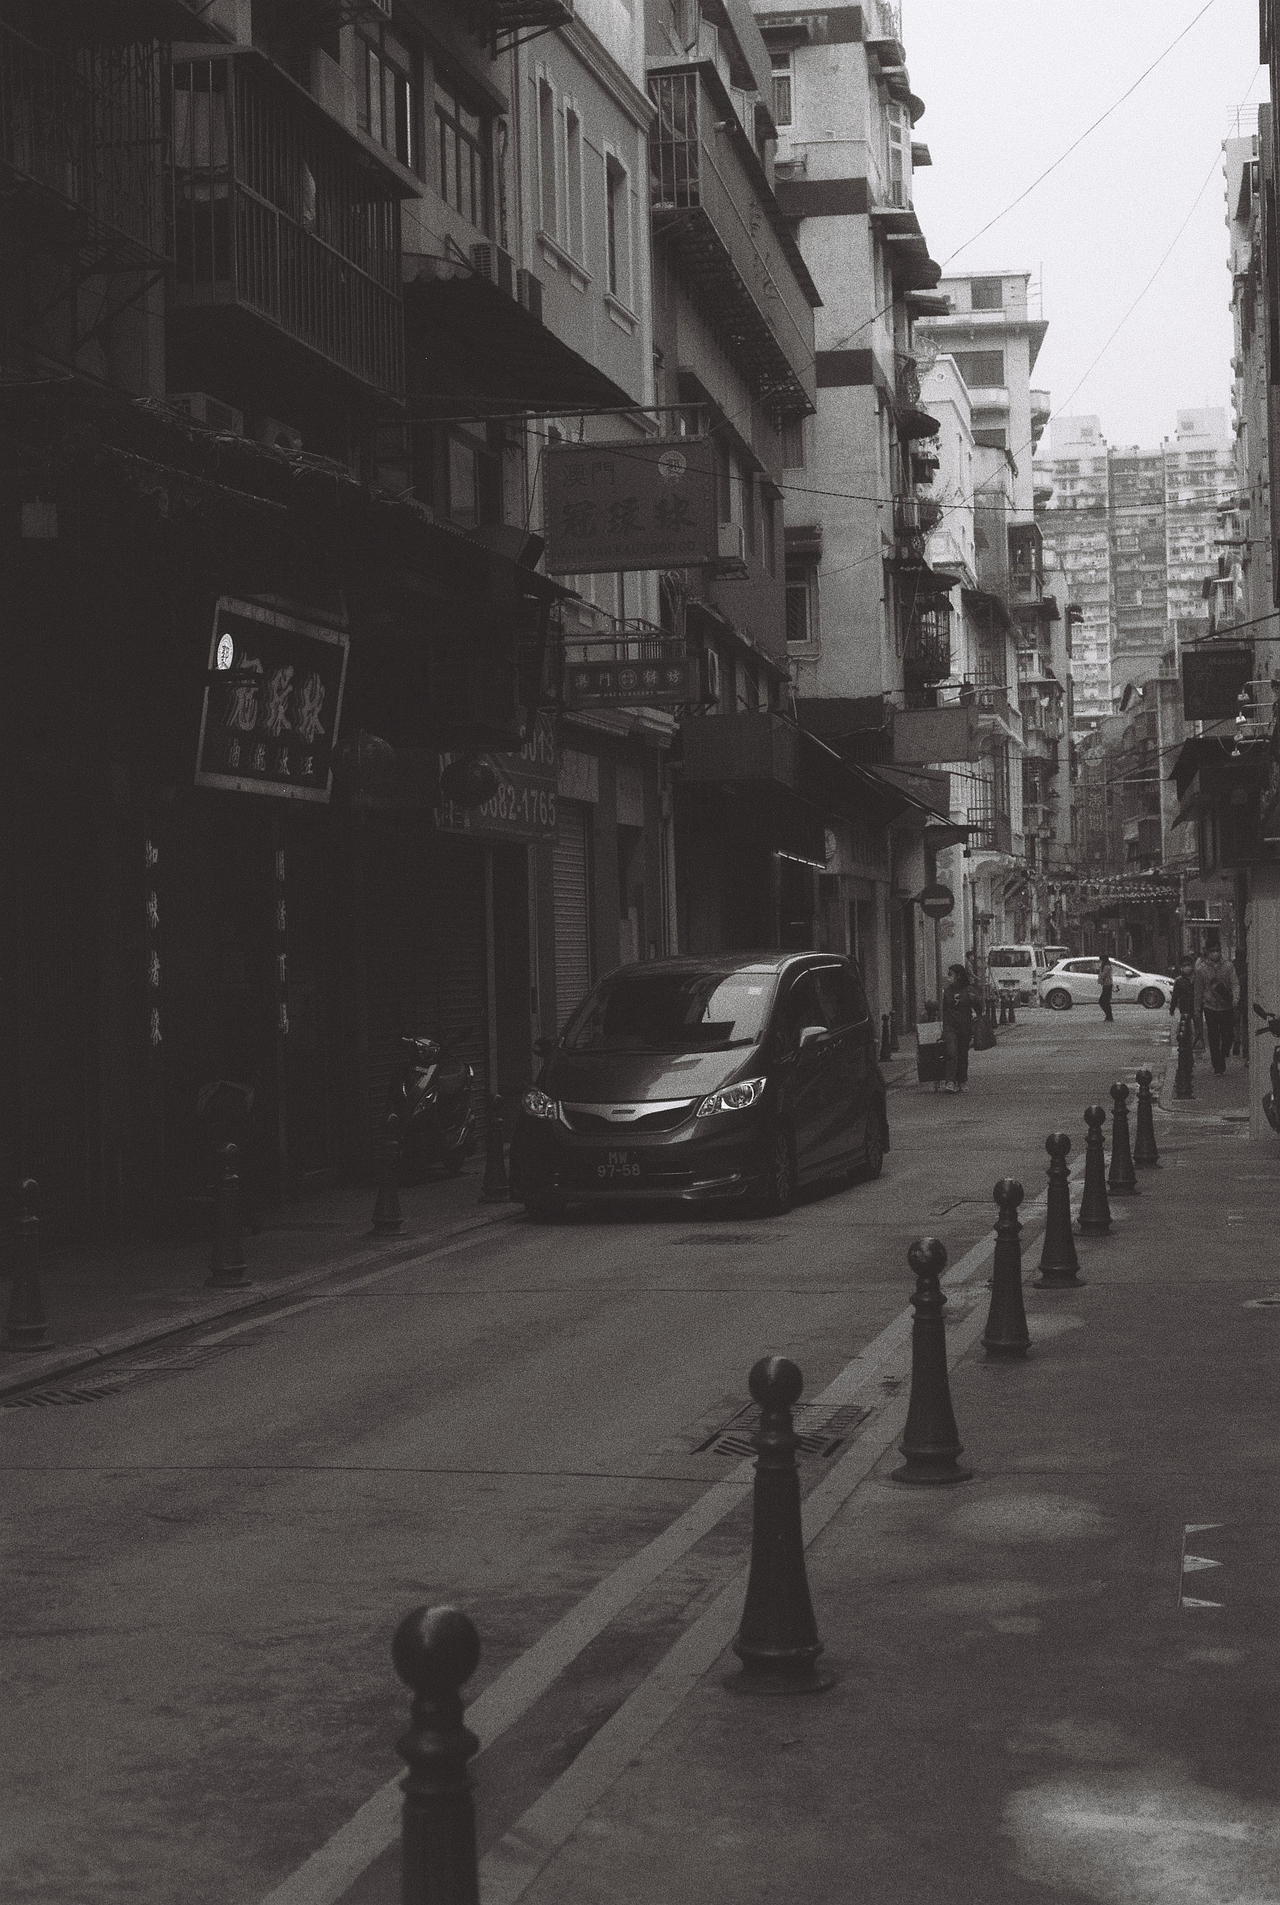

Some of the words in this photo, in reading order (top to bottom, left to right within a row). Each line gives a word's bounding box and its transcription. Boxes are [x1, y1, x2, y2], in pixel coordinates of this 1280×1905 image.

[562, 460, 615, 487] 澳門
[643, 541, 676, 555] FOOD
[608, 1150, 628, 1165] MW
[597, 1164, 641, 1178] 97-58
